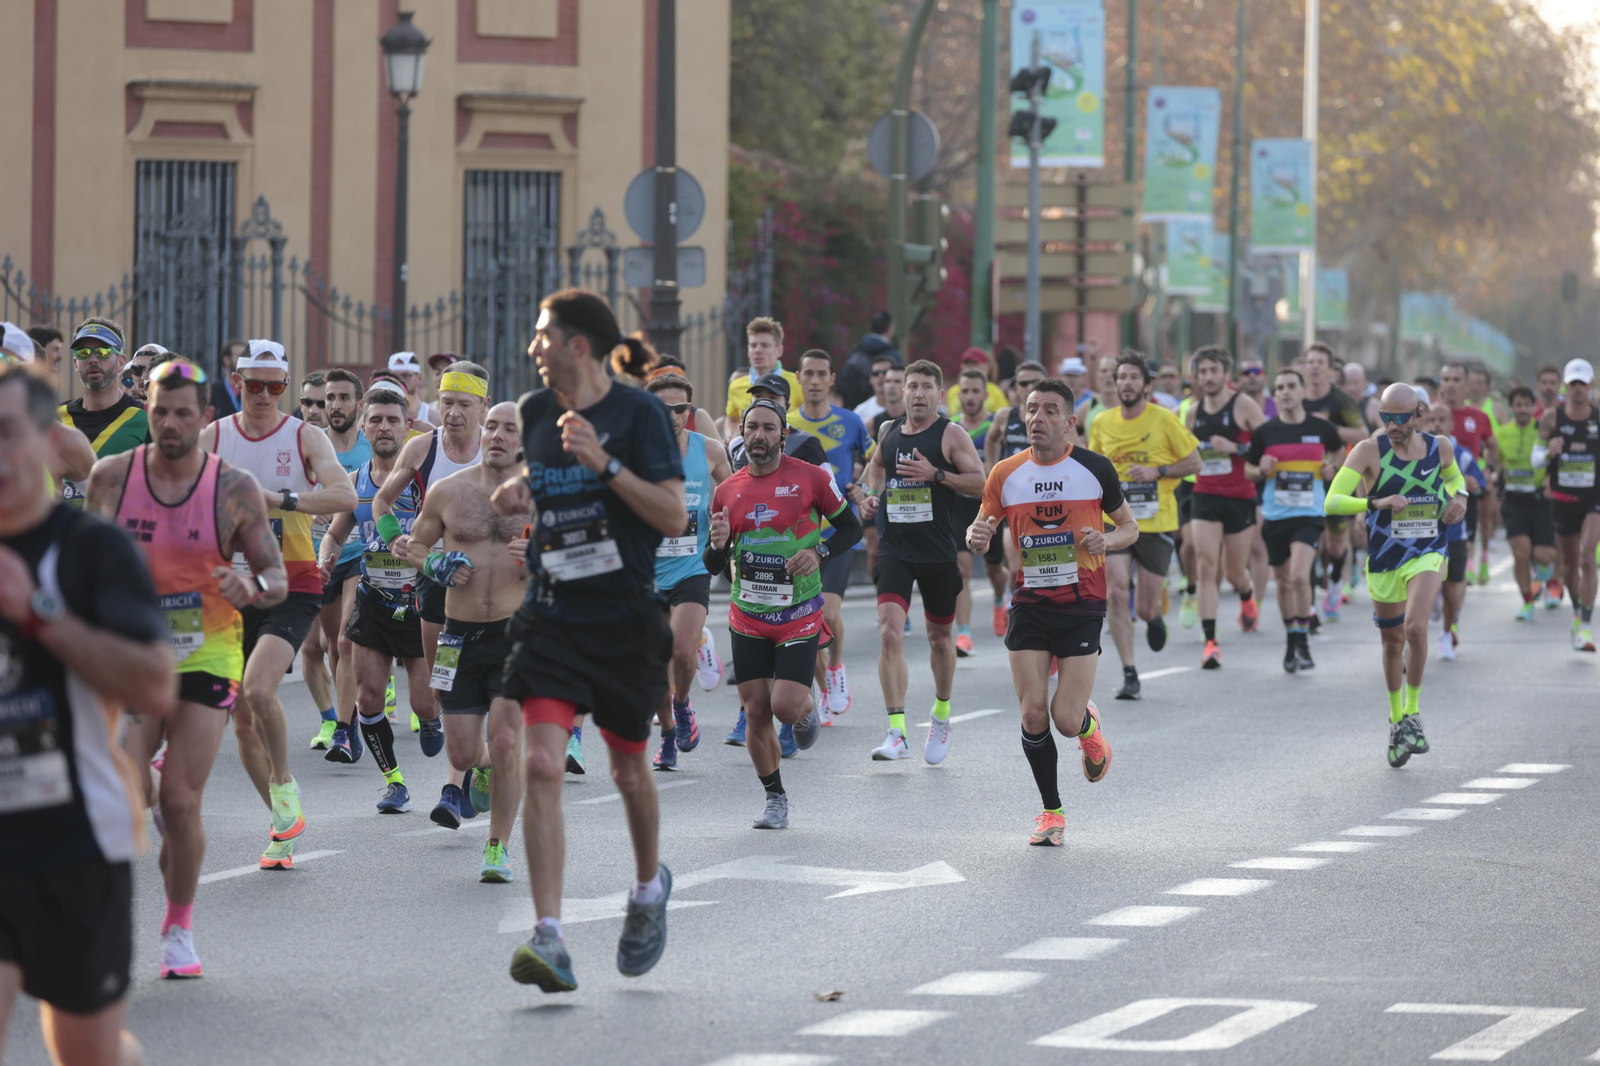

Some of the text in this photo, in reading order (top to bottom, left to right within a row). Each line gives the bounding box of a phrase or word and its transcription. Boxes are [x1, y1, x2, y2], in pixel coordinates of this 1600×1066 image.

[1034, 481, 1063, 494] RUN
[899, 494, 915, 502] 1018
[1041, 492, 1056, 500] FOR
[1035, 503, 1063, 518] FUN
[1034, 535, 1068, 546] ZURICH
[382, 559, 401, 567] 1610
[755, 555, 787, 565] ZURICH
[1037, 553, 1057, 563] 1583
[384, 570, 401, 578] MAYO
[1038, 566, 1059, 575] YAÑEZ
[754, 571, 774, 581] 2895
[751, 583, 778, 593] GERMAN
